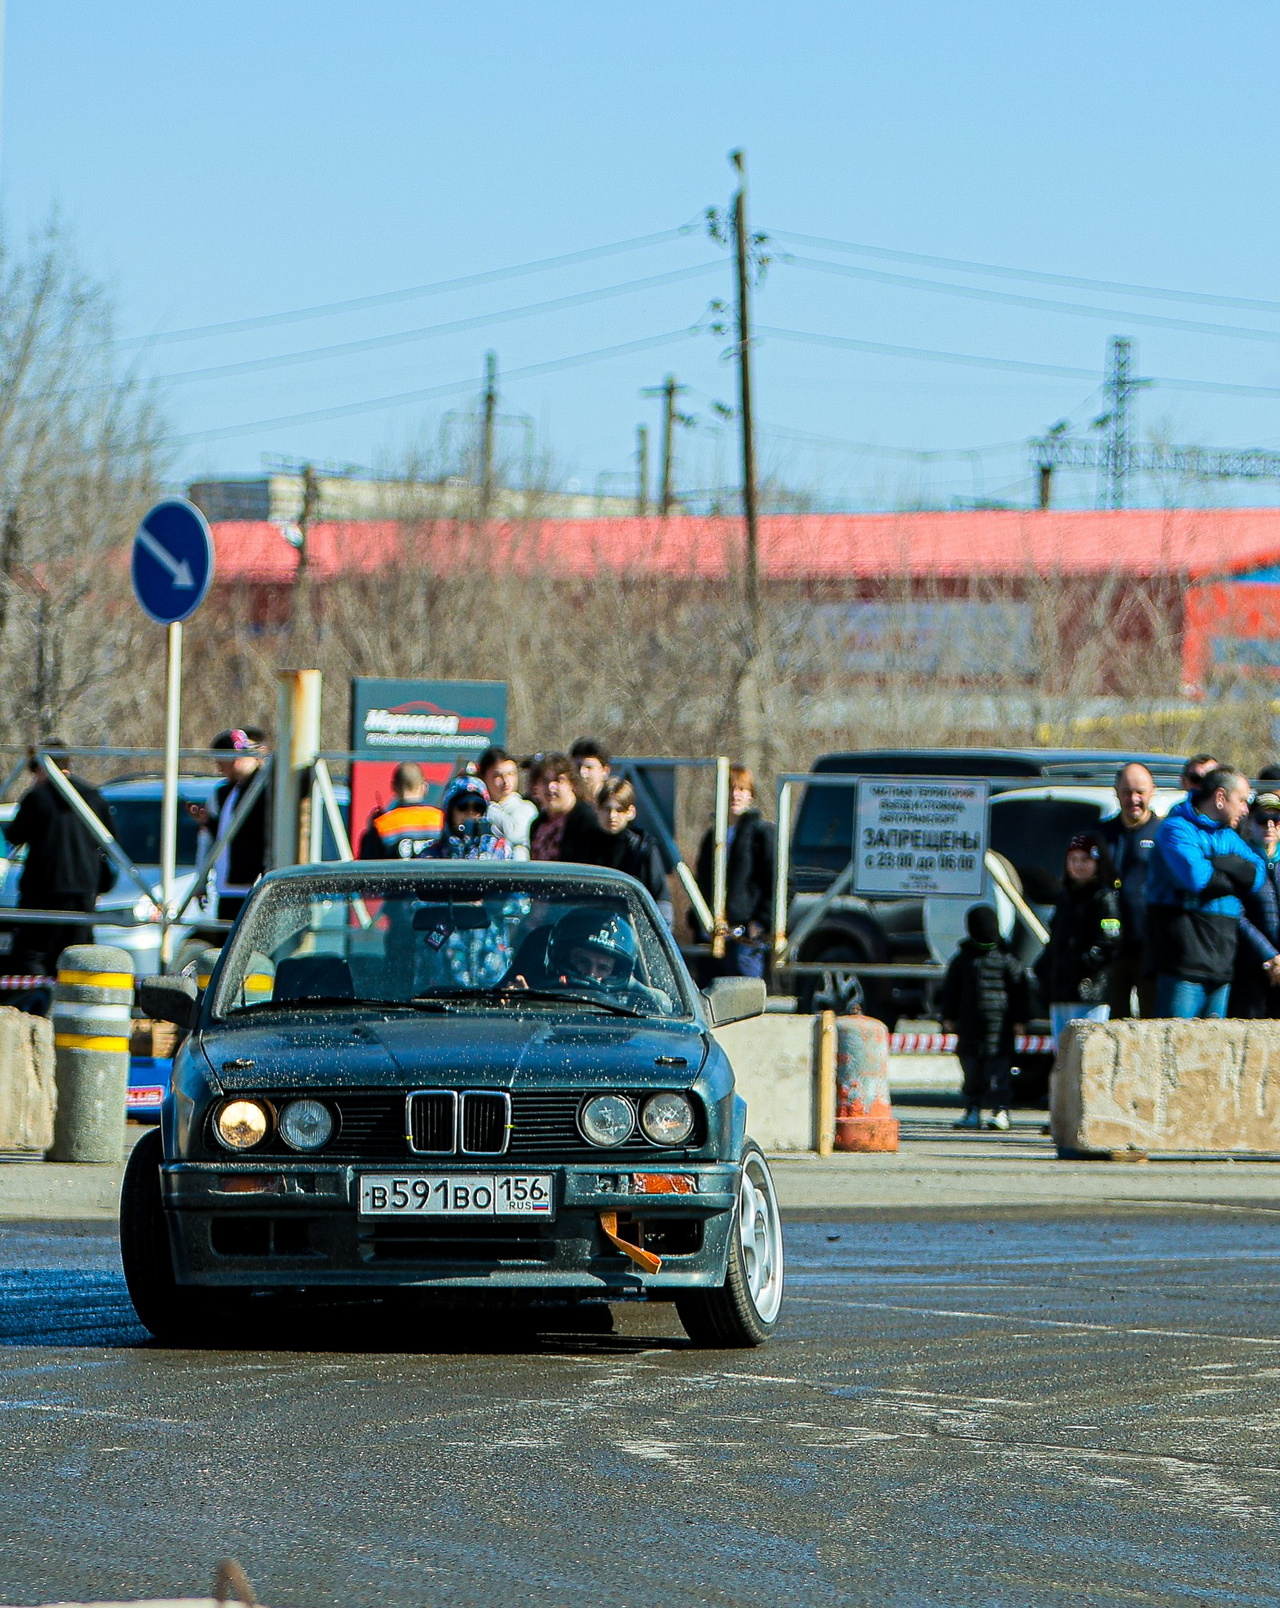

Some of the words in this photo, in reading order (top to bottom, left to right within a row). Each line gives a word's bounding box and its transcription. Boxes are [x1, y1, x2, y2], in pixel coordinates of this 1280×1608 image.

[863, 828, 981, 850] ЗАПРЕЩЕНЫ
[917, 856, 936, 870] до
[371, 1177, 492, 1209] В591ВО
[498, 1177, 545, 1201] 156
[508, 1201, 532, 1210] RUS
